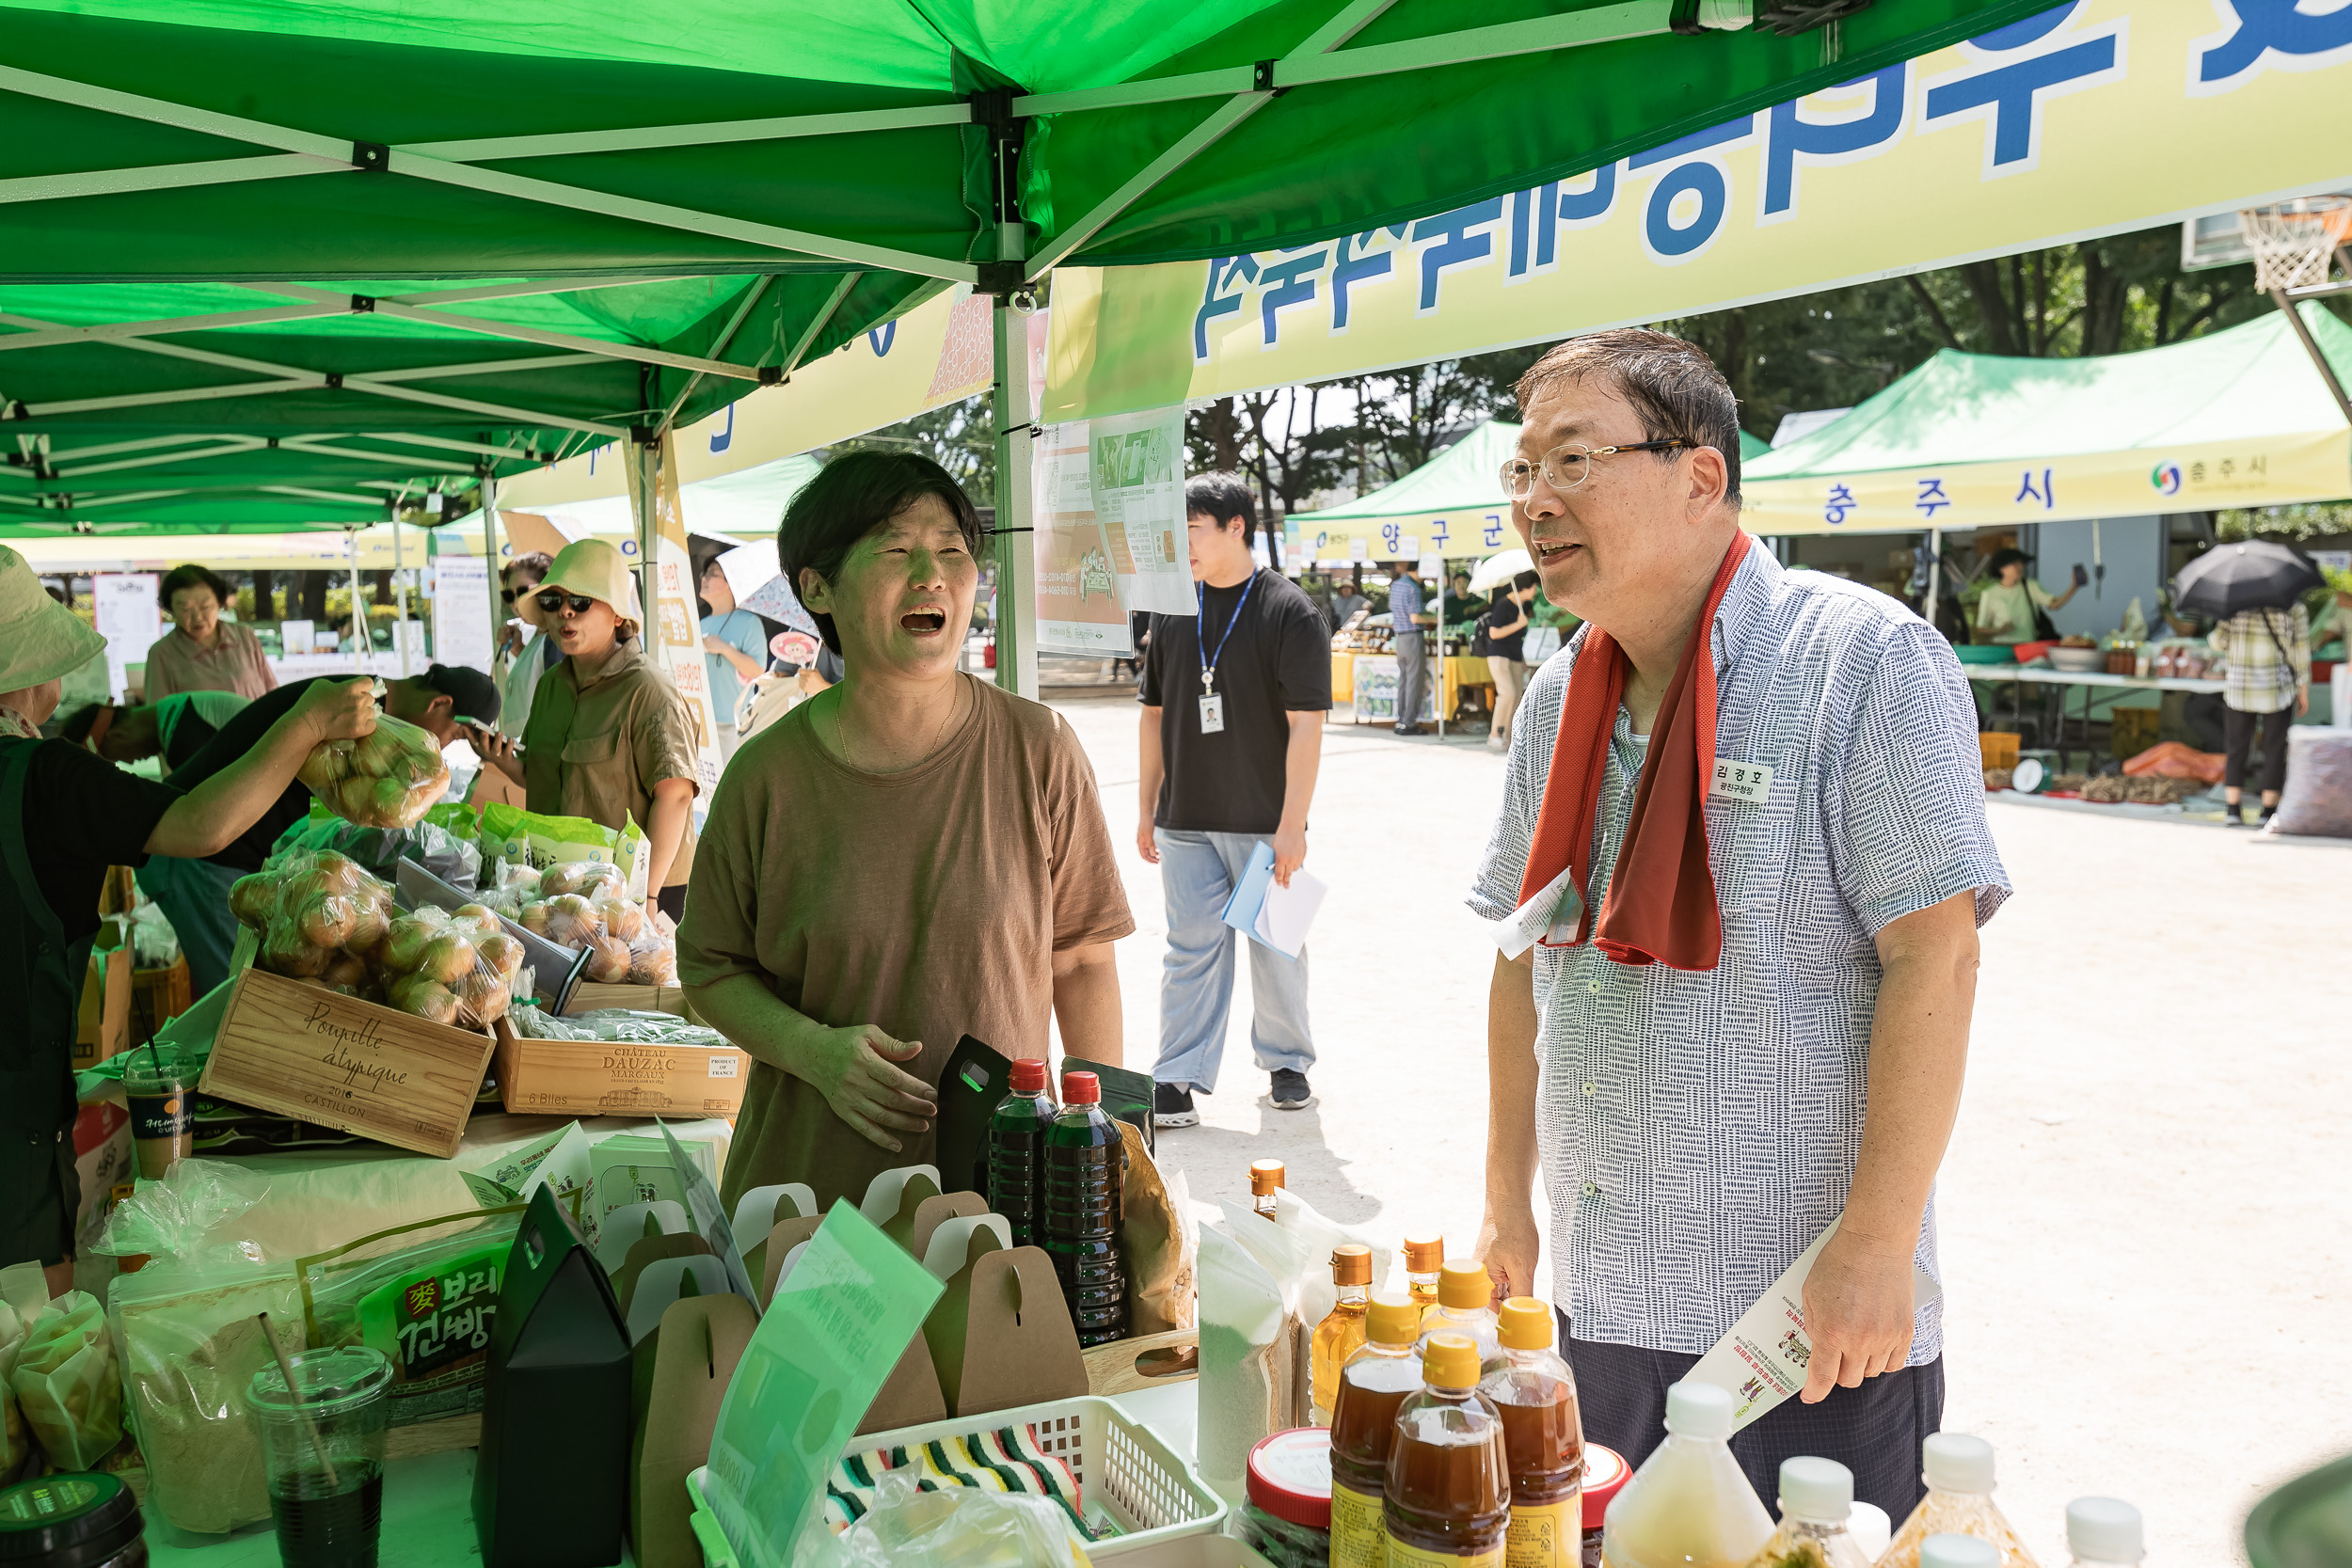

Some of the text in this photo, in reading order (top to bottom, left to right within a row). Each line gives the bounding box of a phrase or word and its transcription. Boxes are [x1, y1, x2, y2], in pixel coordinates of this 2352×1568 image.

[1720, 782, 1754, 796] 광진구청장
[323, 1048, 407, 1093] atypique
[602, 1056, 675, 1070] DAUZAC
[611, 1070, 665, 1079] MARGAUX
[328, 1085, 353, 1100] 2016
[529, 1093, 535, 1104] 6
[304, 1094, 366, 1118] CASTILLON
[409, 1265, 497, 1315] 麥 보리
[396, 1306, 497, 1365] 건빵
